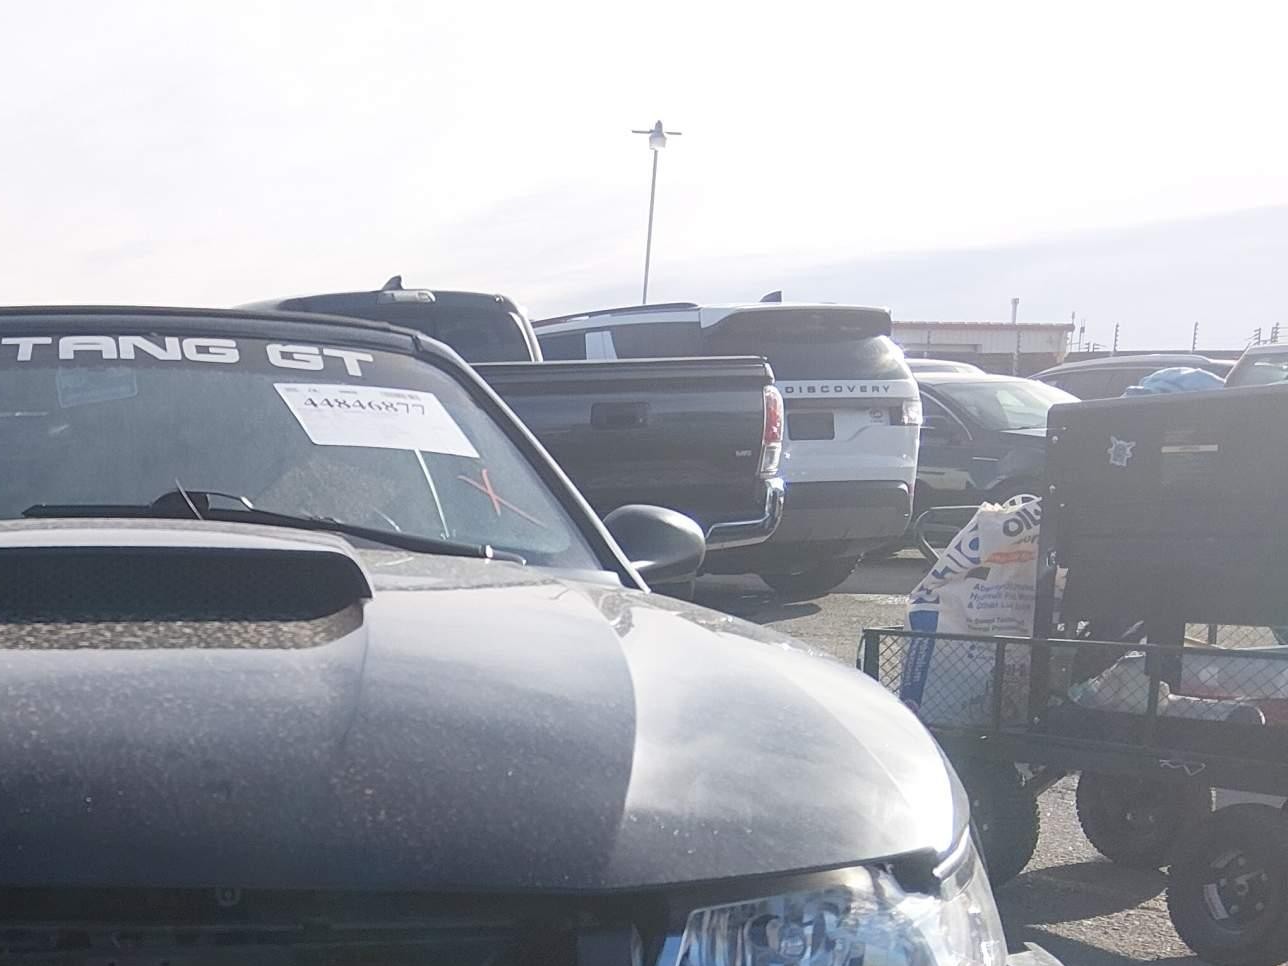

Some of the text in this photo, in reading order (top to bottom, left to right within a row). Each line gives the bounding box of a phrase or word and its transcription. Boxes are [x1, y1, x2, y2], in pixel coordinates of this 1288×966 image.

[266, 343, 374, 377] GT
[785, 385, 890, 394] DISCOVERY
[304, 397, 425, 416] 44846877
